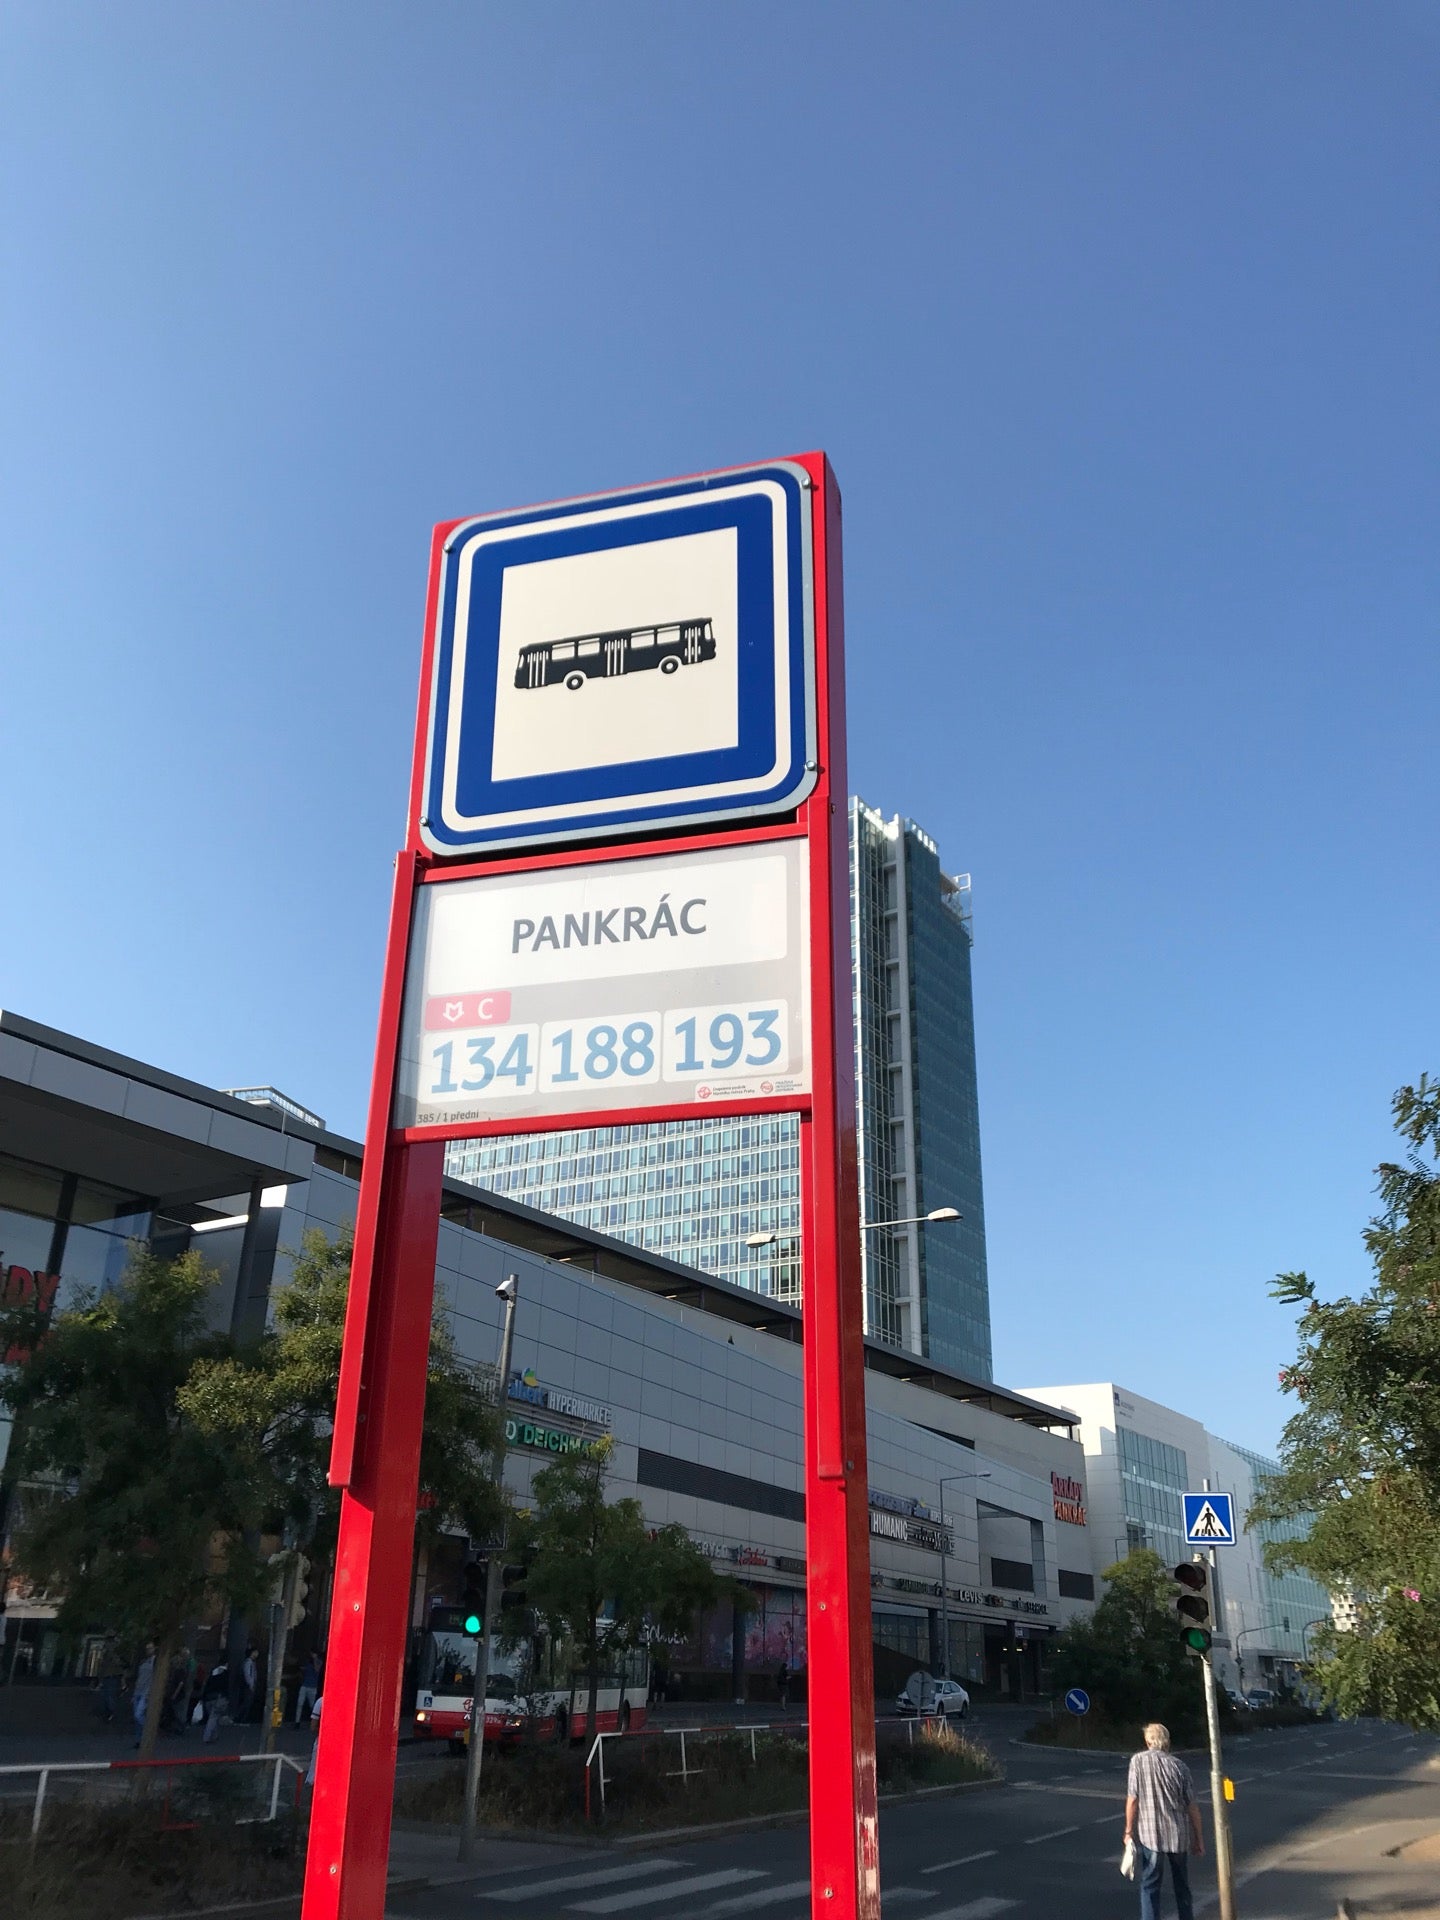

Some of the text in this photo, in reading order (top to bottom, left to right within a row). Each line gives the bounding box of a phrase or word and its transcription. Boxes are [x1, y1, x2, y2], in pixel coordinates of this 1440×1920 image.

[512, 893, 707, 954] PANKRÁC
[477, 998, 494, 1020] C
[431, 1009, 782, 1094] 134 188 193
[417, 1112, 434, 1123] 385
[443, 1112, 448, 1122] 1
[547, 1390, 609, 1425] HYPERMARKET
[523, 1424, 592, 1454] DEICHM
[1051, 1472, 1082, 1501] ARKÁDY
[873, 1511, 908, 1541] HUMANIC
[1054, 1499, 1087, 1527] PANKRÁC
